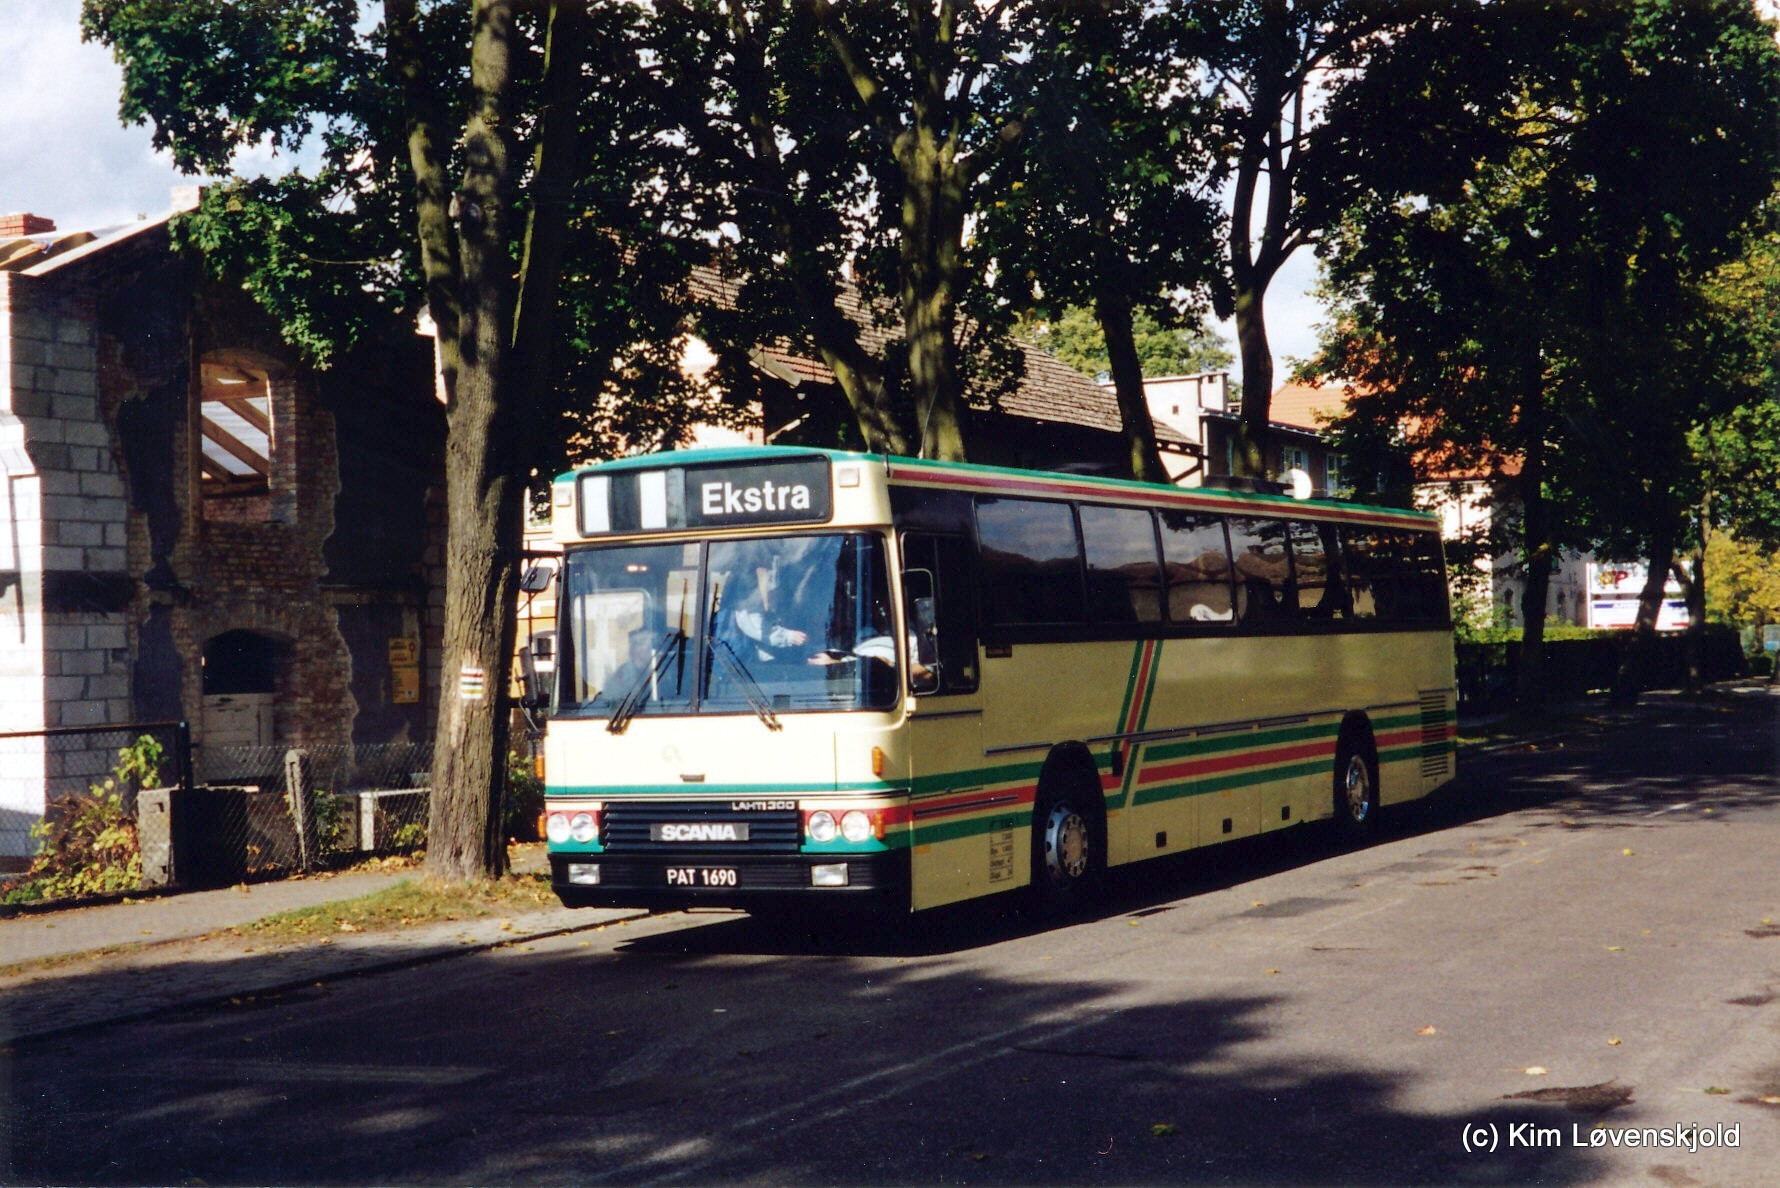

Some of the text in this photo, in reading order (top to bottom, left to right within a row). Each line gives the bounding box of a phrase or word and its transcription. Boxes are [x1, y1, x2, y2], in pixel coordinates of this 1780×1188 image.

[702, 480, 810, 515] Ekstra
[731, 801, 766, 811] LAHTI
[661, 824, 737, 841] SCANIA
[667, 868, 737, 886] PAT 1690
